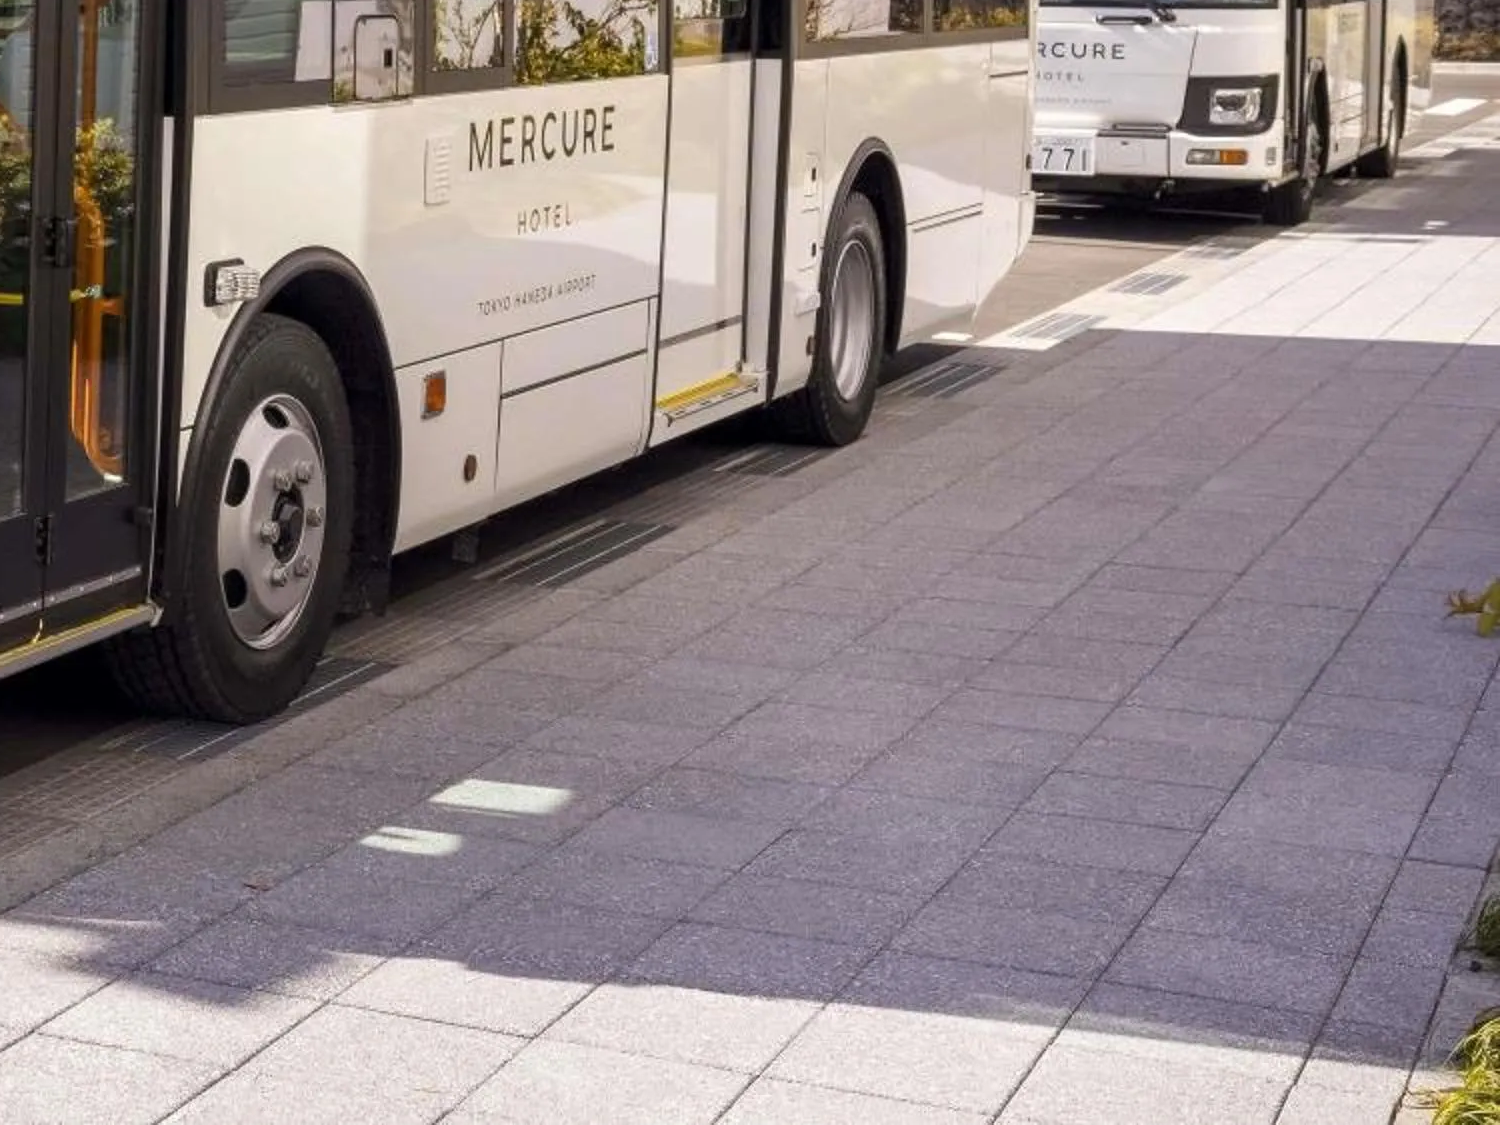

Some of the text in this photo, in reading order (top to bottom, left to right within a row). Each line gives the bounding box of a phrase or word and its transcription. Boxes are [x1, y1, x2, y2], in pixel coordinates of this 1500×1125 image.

[1037, 42, 1125, 60] RCURE
[468, 105, 616, 172] MERCURE
[516, 204, 572, 236] HOTEL
